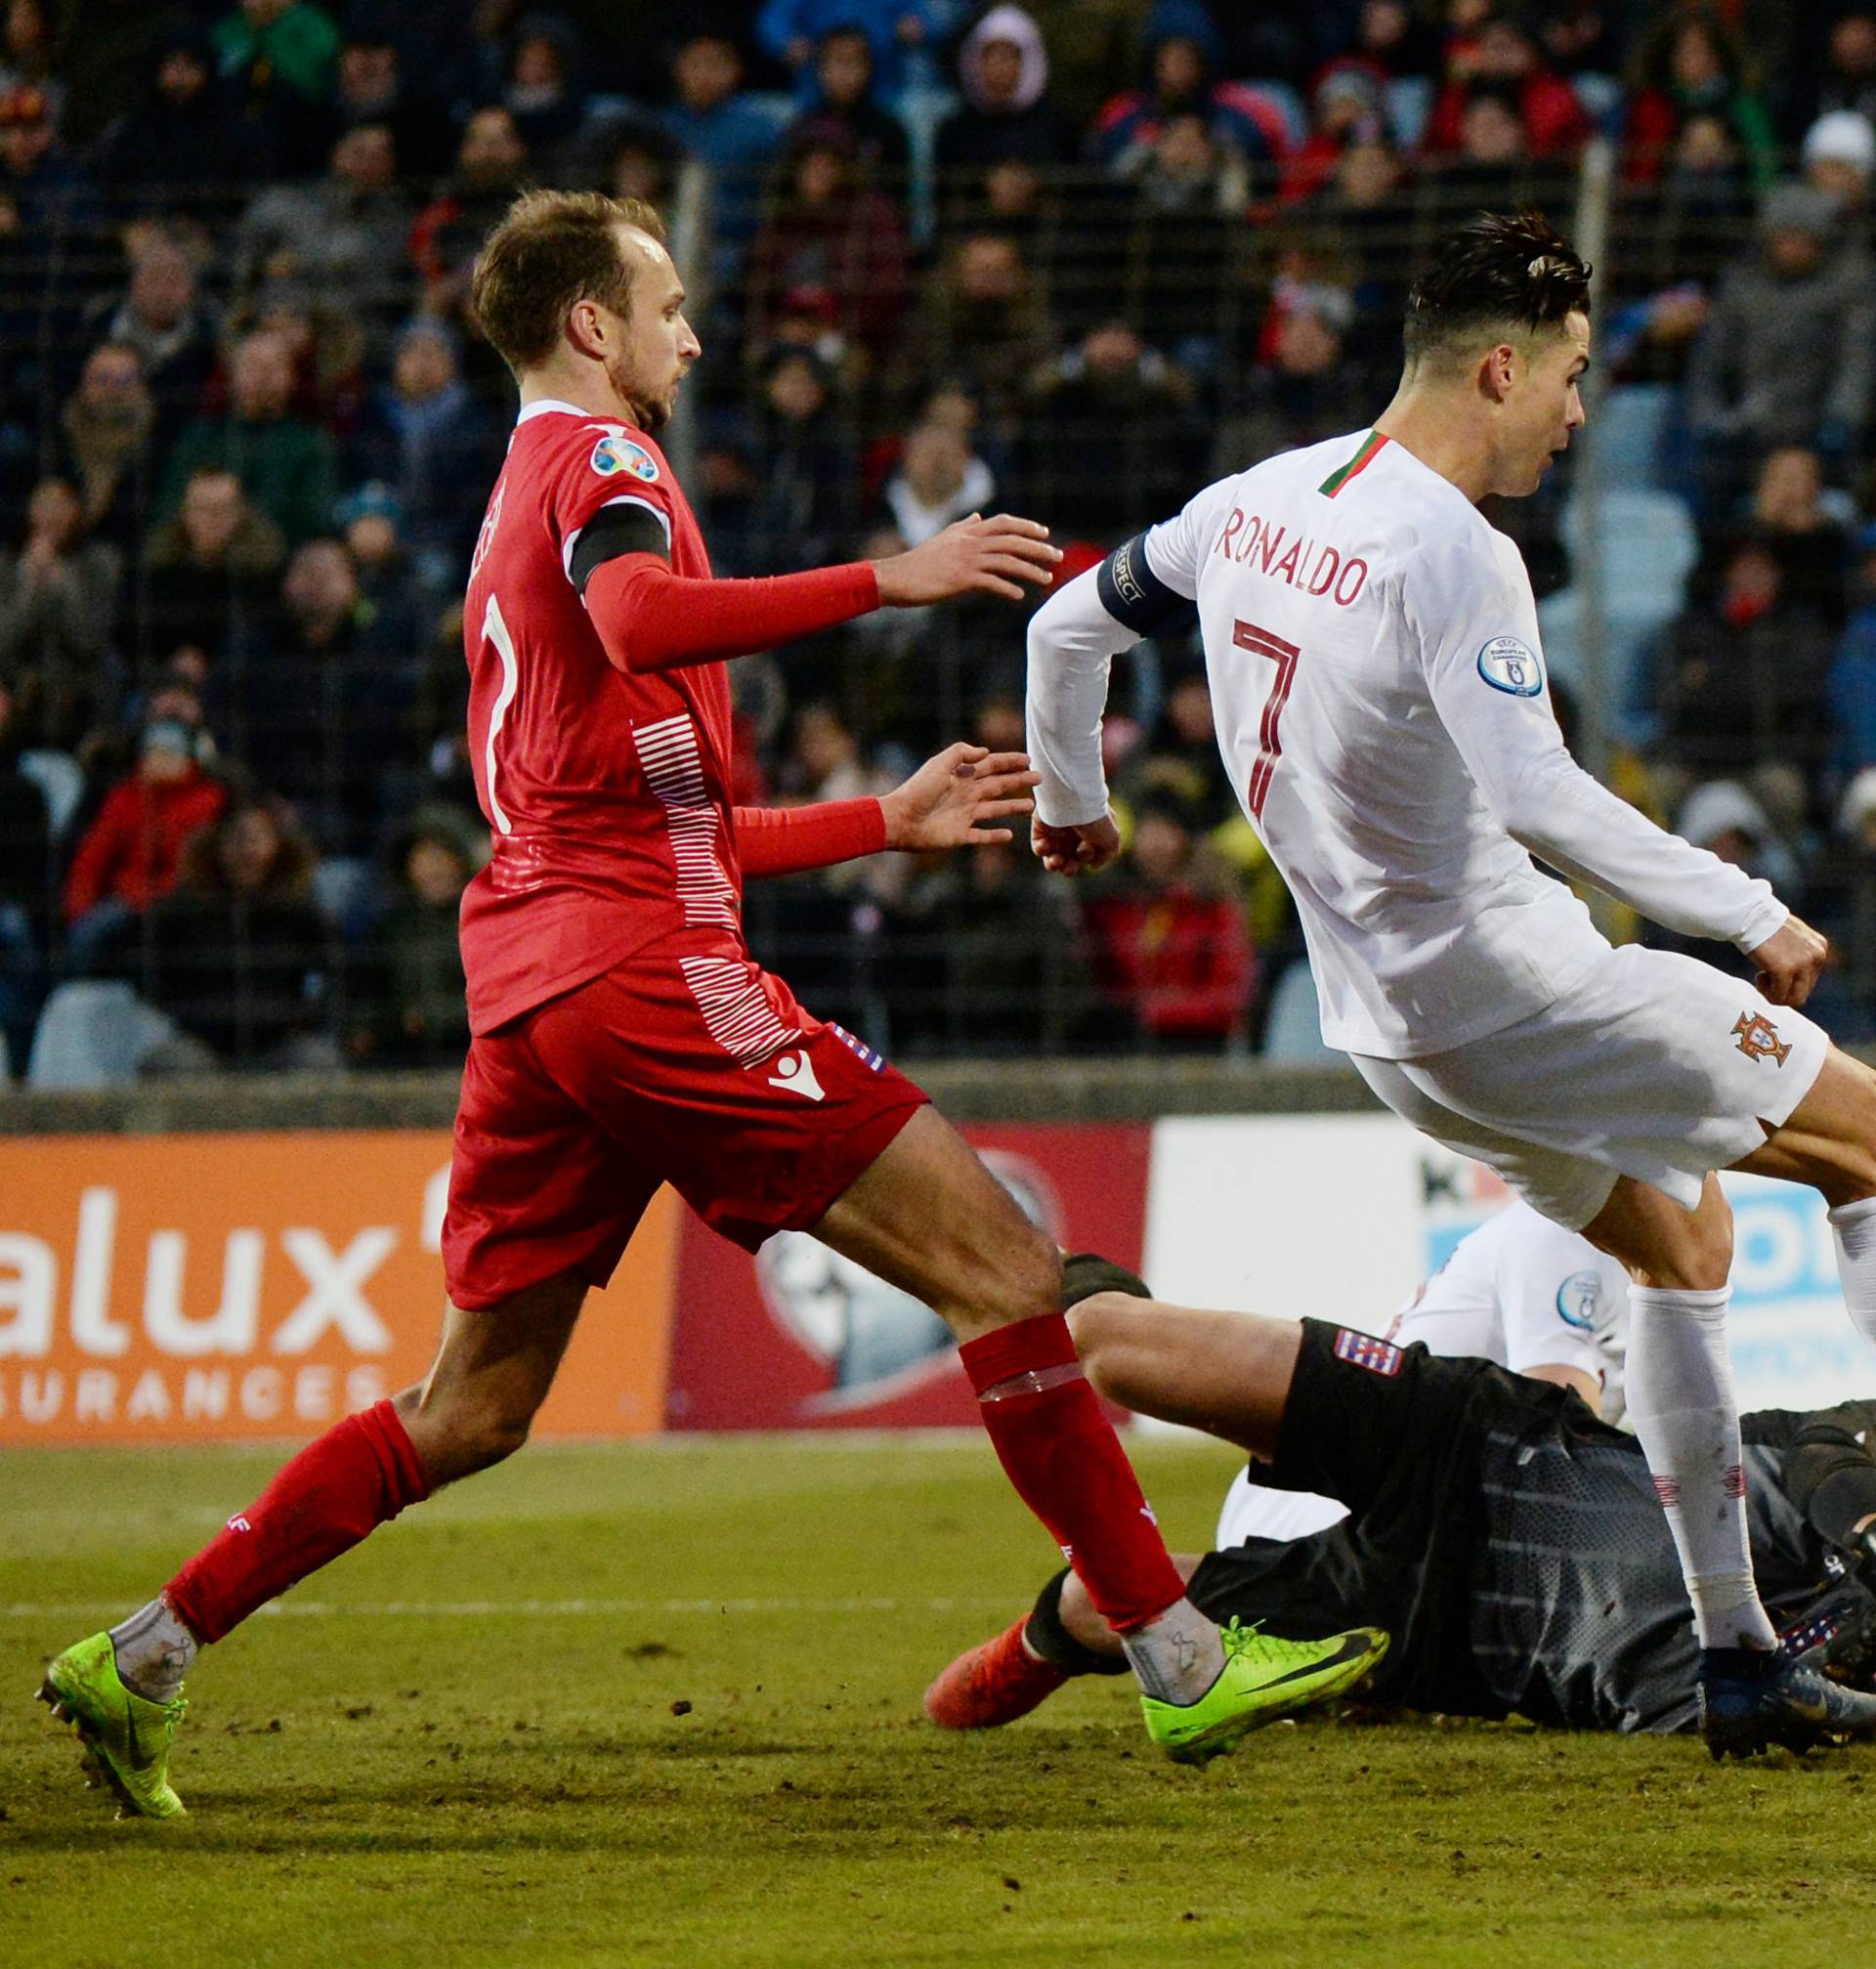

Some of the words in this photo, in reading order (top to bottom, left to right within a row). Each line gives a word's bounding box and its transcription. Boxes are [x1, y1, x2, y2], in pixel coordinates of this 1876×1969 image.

[1215, 507, 1368, 607] RONALDO
[1232, 618, 1300, 821] 7
[0, 1366, 389, 1424] URANCES
